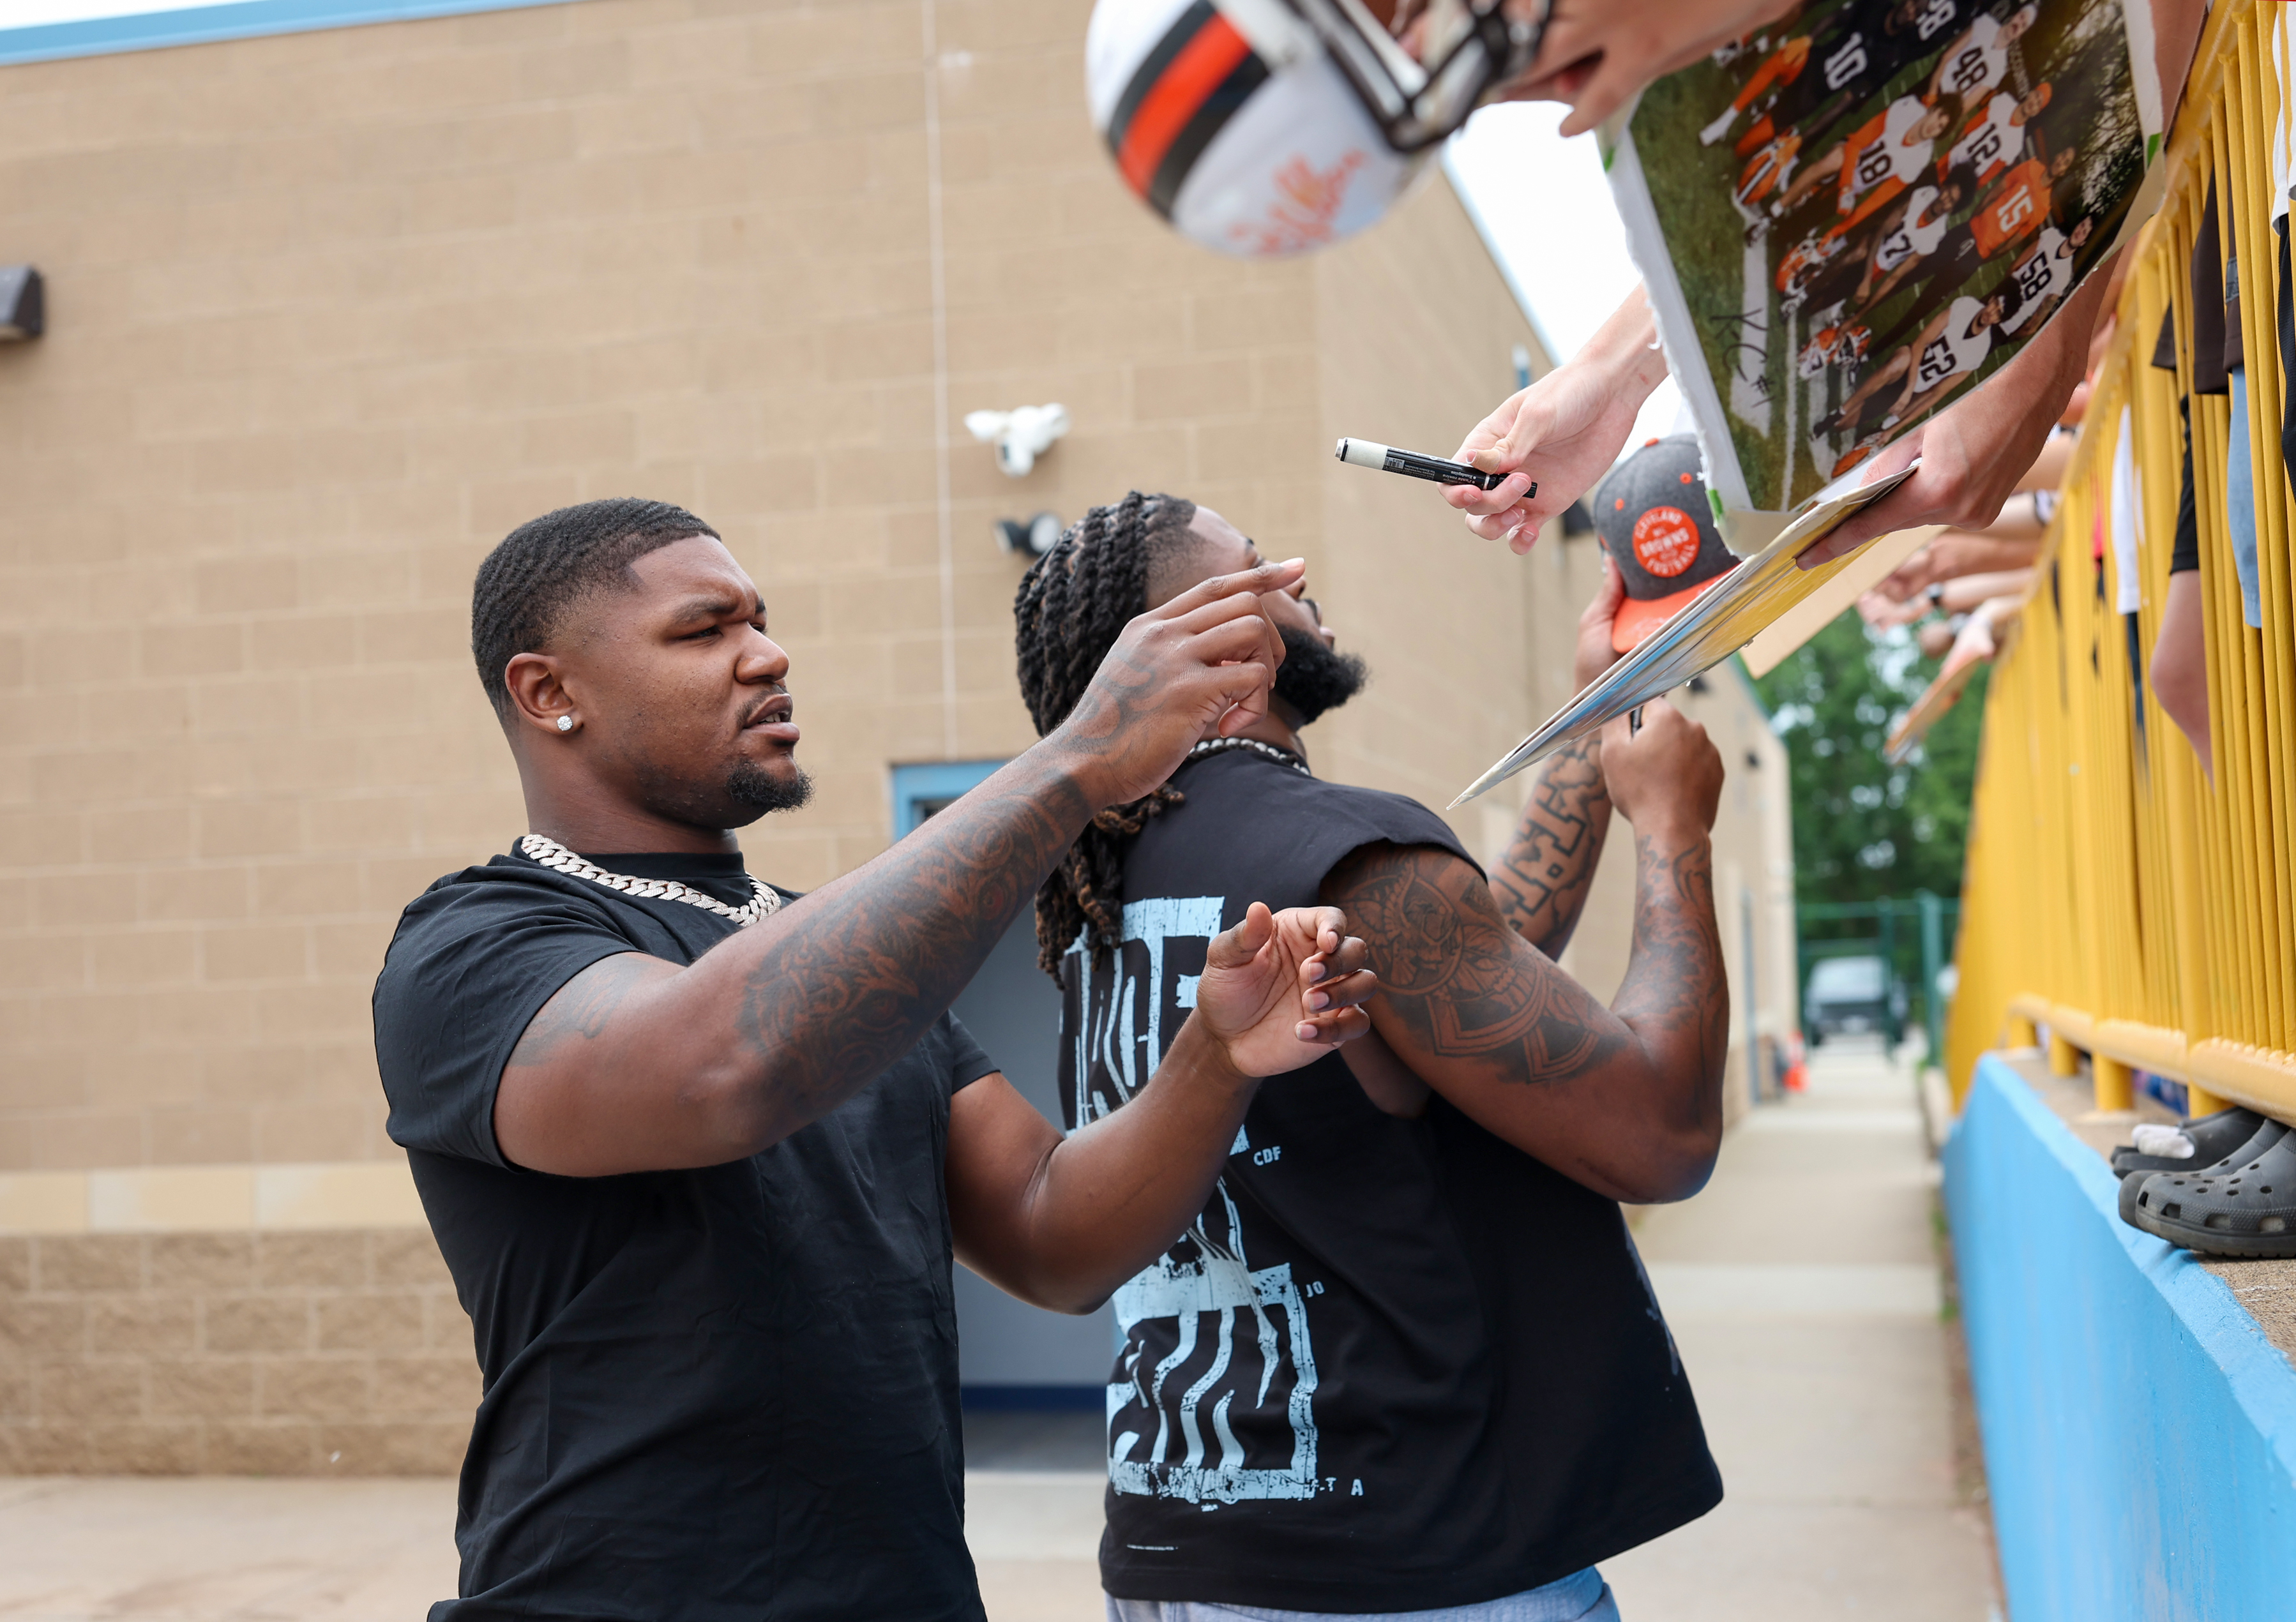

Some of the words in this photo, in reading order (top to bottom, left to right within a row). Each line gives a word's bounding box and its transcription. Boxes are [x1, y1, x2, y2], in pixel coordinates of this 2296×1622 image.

[1824, 32, 1868, 90] 10
[1952, 47, 1988, 93] 48
[1857, 140, 1892, 184] 18
[1967, 123, 2001, 167] 12
[1997, 185, 2034, 232] 15
[2020, 251, 2052, 301] 58
[1919, 336, 1957, 382] 52
[1639, 528, 1690, 557] BROWNS
[1253, 1146, 1281, 1166] CDF
